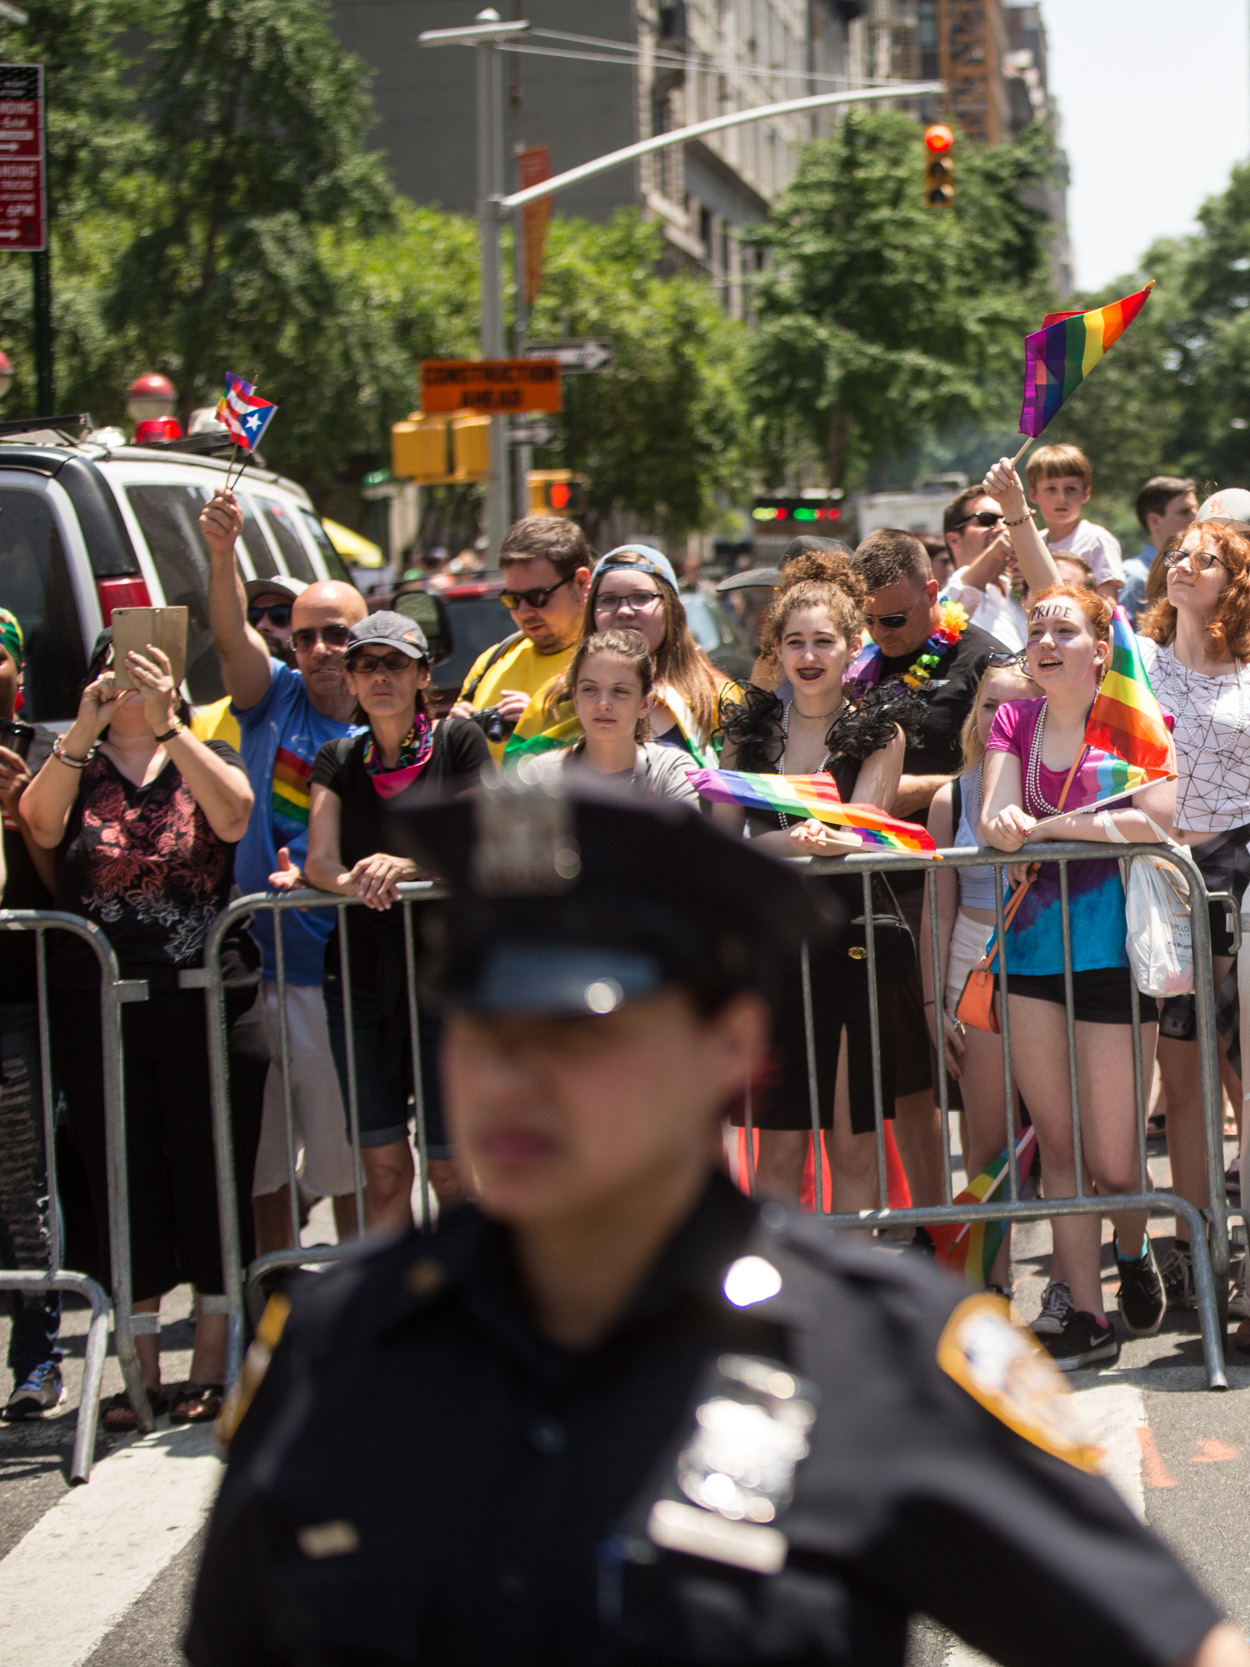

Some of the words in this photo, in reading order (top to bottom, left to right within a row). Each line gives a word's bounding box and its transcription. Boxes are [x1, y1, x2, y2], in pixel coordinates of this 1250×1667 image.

[424, 366, 556, 384] CONSTRUCTION
[461, 390, 522, 407] AHEAD
[1031, 604, 1072, 621] PRIDE
